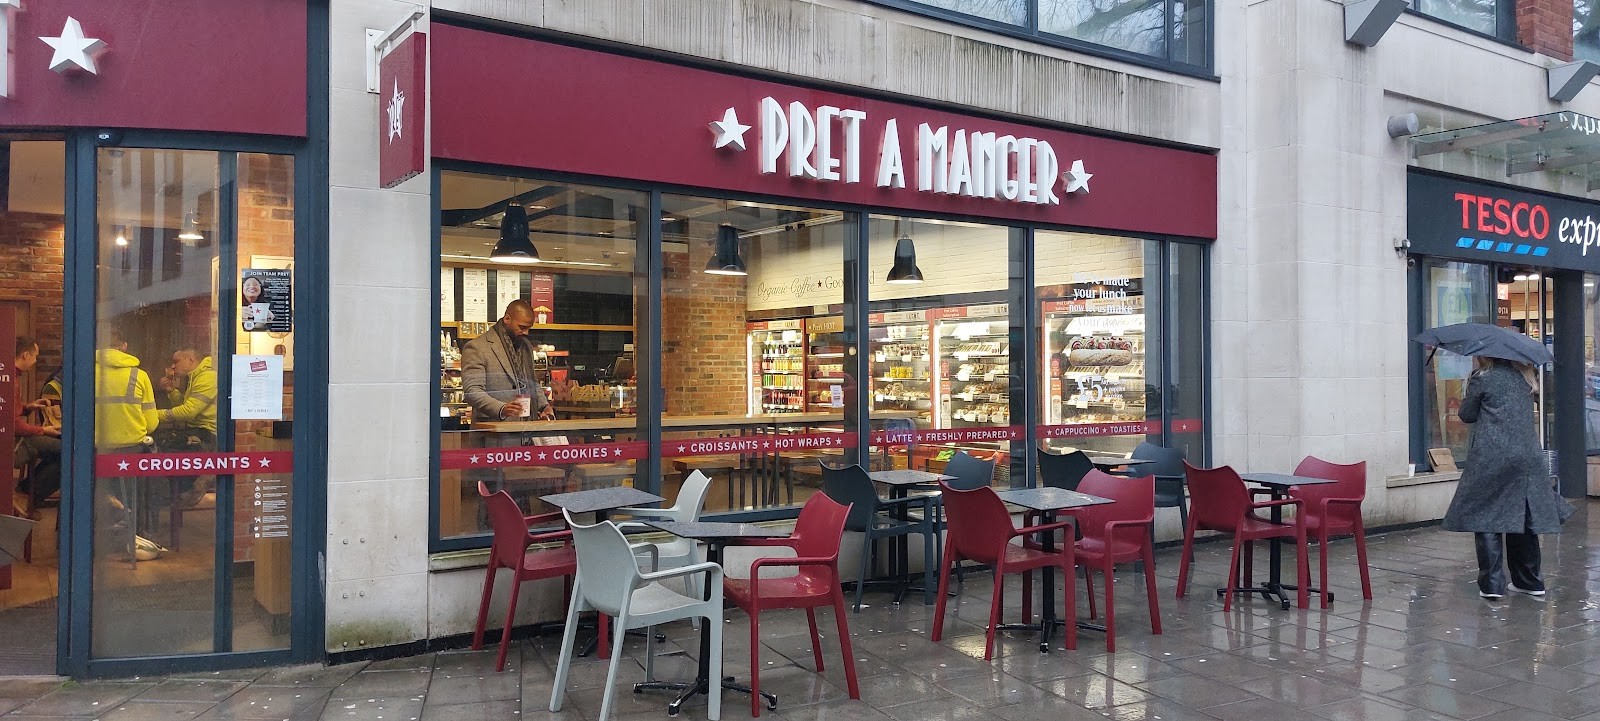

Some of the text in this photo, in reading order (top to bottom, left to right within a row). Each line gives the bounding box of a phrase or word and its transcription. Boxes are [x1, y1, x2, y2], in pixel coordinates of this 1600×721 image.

[762, 96, 1060, 205] PRET A MANGER
[1454, 192, 1550, 240] TESCO
[757, 281, 787, 301] Organic
[1073, 287, 1127, 301] your lunch
[1106, 302, 1133, 314] make
[885, 430, 1008, 443] LATTE FRESHLY PREPARED
[1054, 425, 1141, 436] CAPPUCCINO TOASTIES
[690, 436, 832, 453] CROISSANTS HOT WRAPS
[138, 456, 251, 471] CROISSANTS
[486, 447, 608, 464] SOUPS COOKIES
